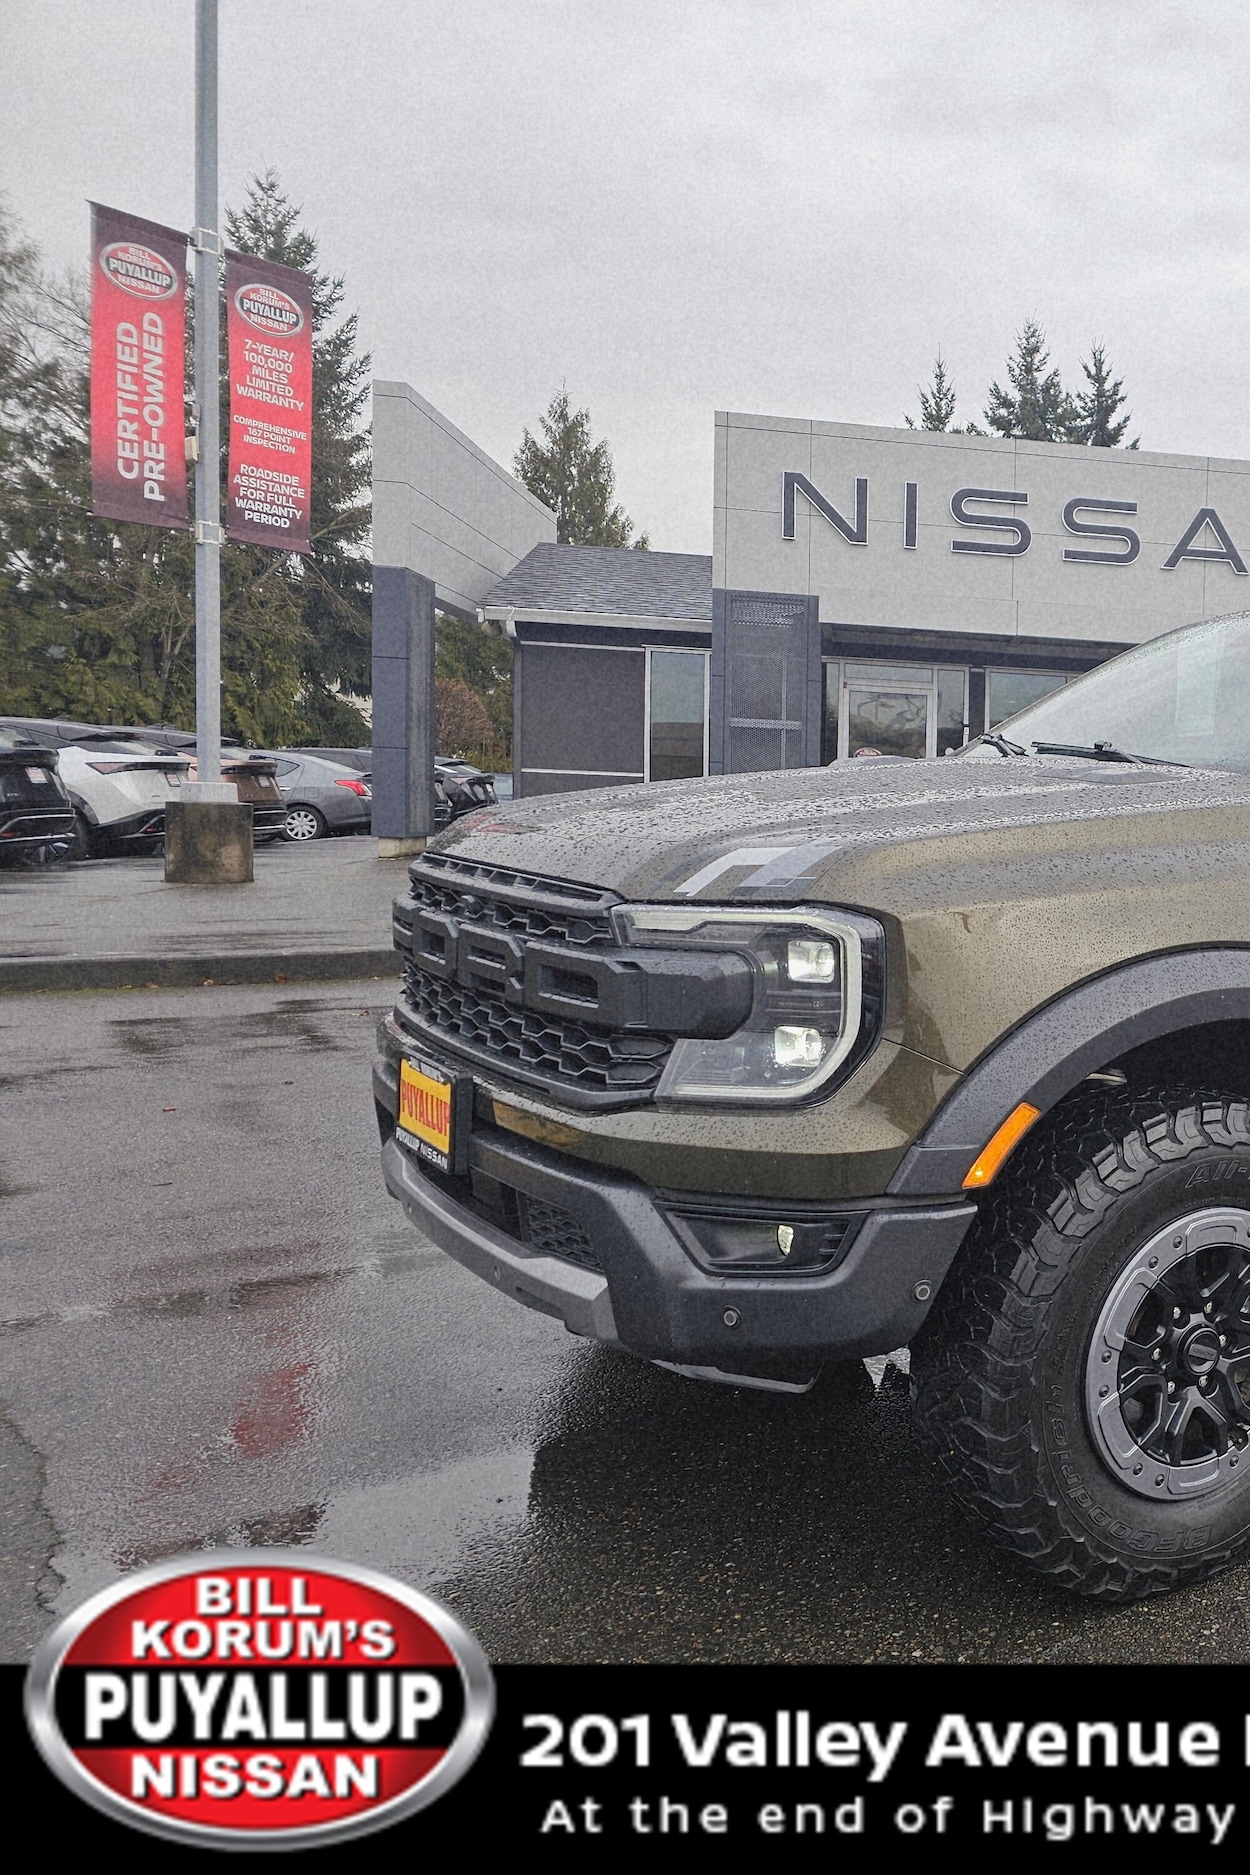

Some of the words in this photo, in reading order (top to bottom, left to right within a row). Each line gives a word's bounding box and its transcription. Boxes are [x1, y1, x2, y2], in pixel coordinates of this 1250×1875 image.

[128, 247, 152, 261] BILL
[108, 258, 172, 288] PUYALLUP
[117, 274, 160, 294] NISSAN
[249, 292, 291, 311] KORUM'S
[259, 288, 279, 301] BILL
[243, 298, 298, 325] PUYALLUP
[249, 313, 289, 332] NISSAN
[243, 350, 294, 374] 100,000
[244, 338, 295, 363] 7-YEAR/
[245, 374, 294, 397] LIMITED
[251, 364, 289, 384] MILES
[116, 321, 140, 481] CERTIFIED
[142, 311, 166, 502] PRE-OWNED
[235, 383, 304, 412] WARRANTY
[232, 414, 308, 441] COMPREHENSIVE
[247, 427, 263, 437] 167
[264, 431, 292, 446] POINT
[243, 434, 296, 455] INSPECTION
[233, 474, 306, 499] ASSISTANCE
[240, 463, 300, 487] ROADSIDE
[234, 496, 303, 520] WARRANTY
[240, 486, 265, 501] FOR
[266, 493, 297, 508] FULL
[244, 510, 290, 529] PERIOD
[401, 1078, 451, 1137] PUYALLUP
[420, 1142, 448, 1170] NISSAN
